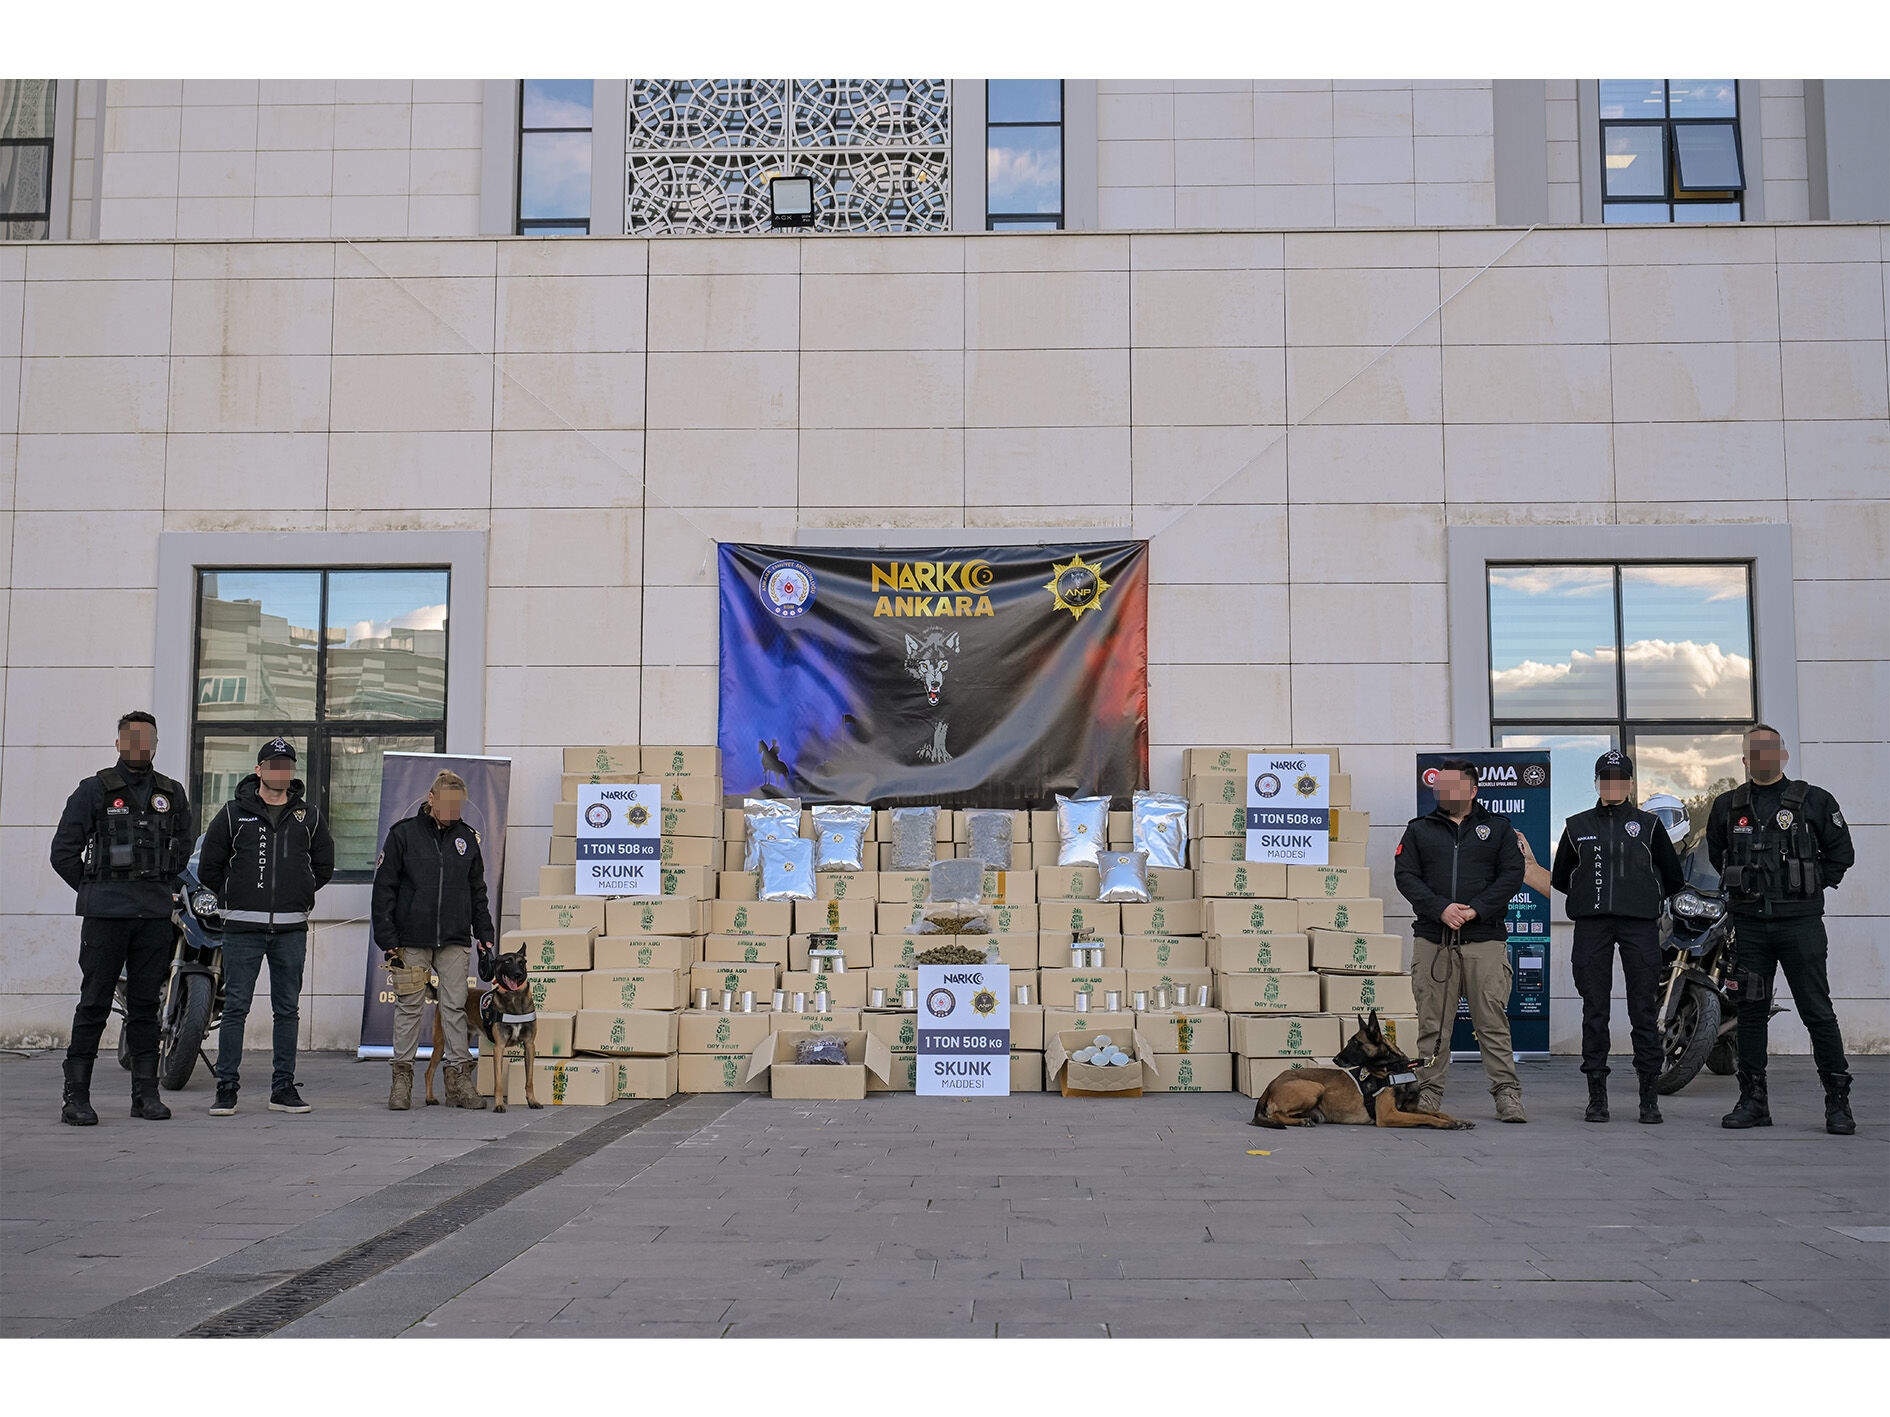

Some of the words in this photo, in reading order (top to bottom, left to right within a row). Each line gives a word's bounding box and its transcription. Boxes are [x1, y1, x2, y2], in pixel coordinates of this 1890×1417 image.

[1065, 588, 1092, 597] ANP
[873, 596, 995, 617] ANKARA
[1492, 799, 1525, 813] OLUN!
[1253, 813, 1258, 824] 1
[1260, 814, 1284, 824] TON
[1287, 814, 1308, 824] 508
[1310, 816, 1322, 824] KG
[1261, 835, 1312, 847] SKUNK
[584, 844, 588, 854] 1
[591, 844, 615, 854] TON
[618, 844, 640, 854] 508
[642, 846, 654, 854] KG
[1267, 849, 1306, 859] MADDESİ
[592, 865, 644, 878] SKUNK
[598, 879, 638, 889] MADDESİ
[925, 1036, 930, 1048] 1
[933, 1036, 959, 1048] TON
[963, 1036, 987, 1048] 508
[989, 1039, 1002, 1048] KG
[934, 1061, 992, 1076] SKUNK
[941, 1078, 985, 1089] MADDESİ
